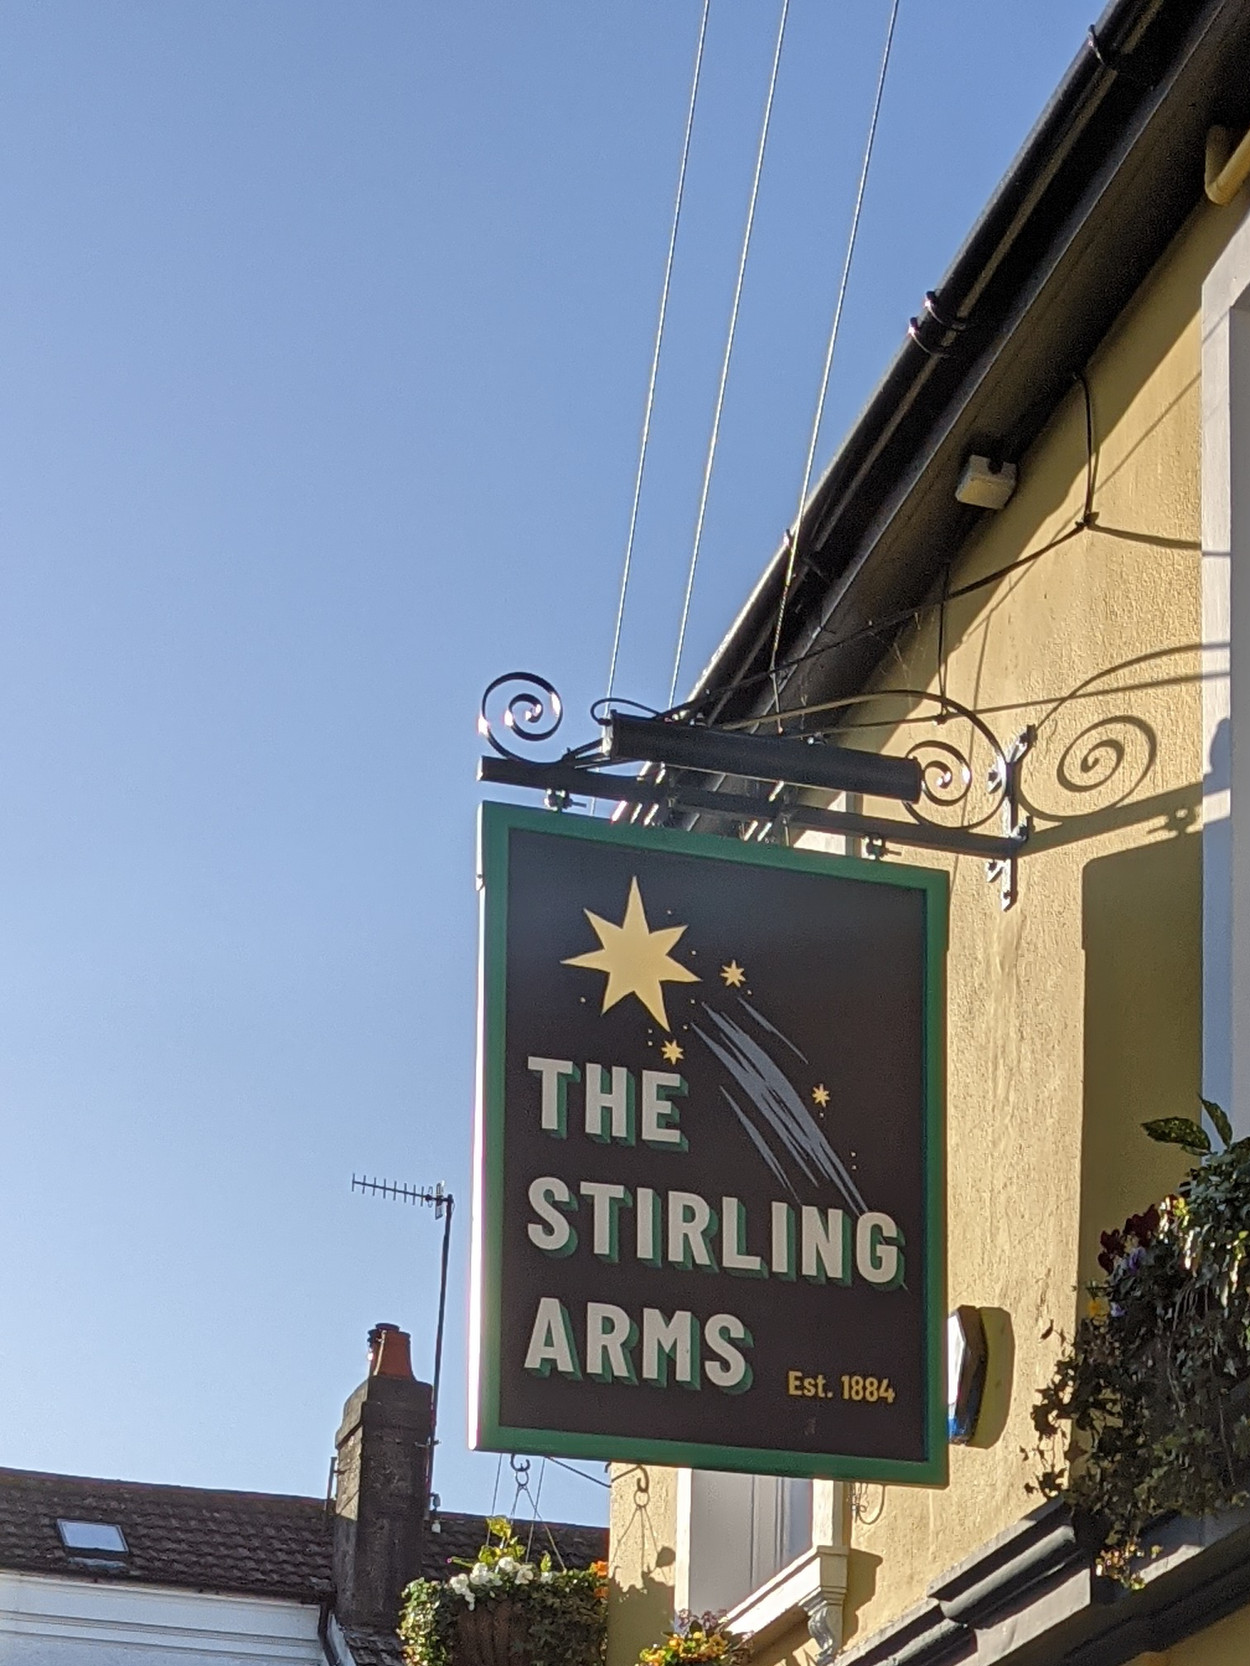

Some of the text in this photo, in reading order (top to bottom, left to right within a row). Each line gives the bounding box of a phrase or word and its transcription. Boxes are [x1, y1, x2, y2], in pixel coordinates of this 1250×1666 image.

[526, 1055, 688, 1151] THE
[527, 1176, 905, 1288] STIRLING
[523, 1297, 754, 1393] ARMS
[788, 1370, 896, 1404] Est. 1884
